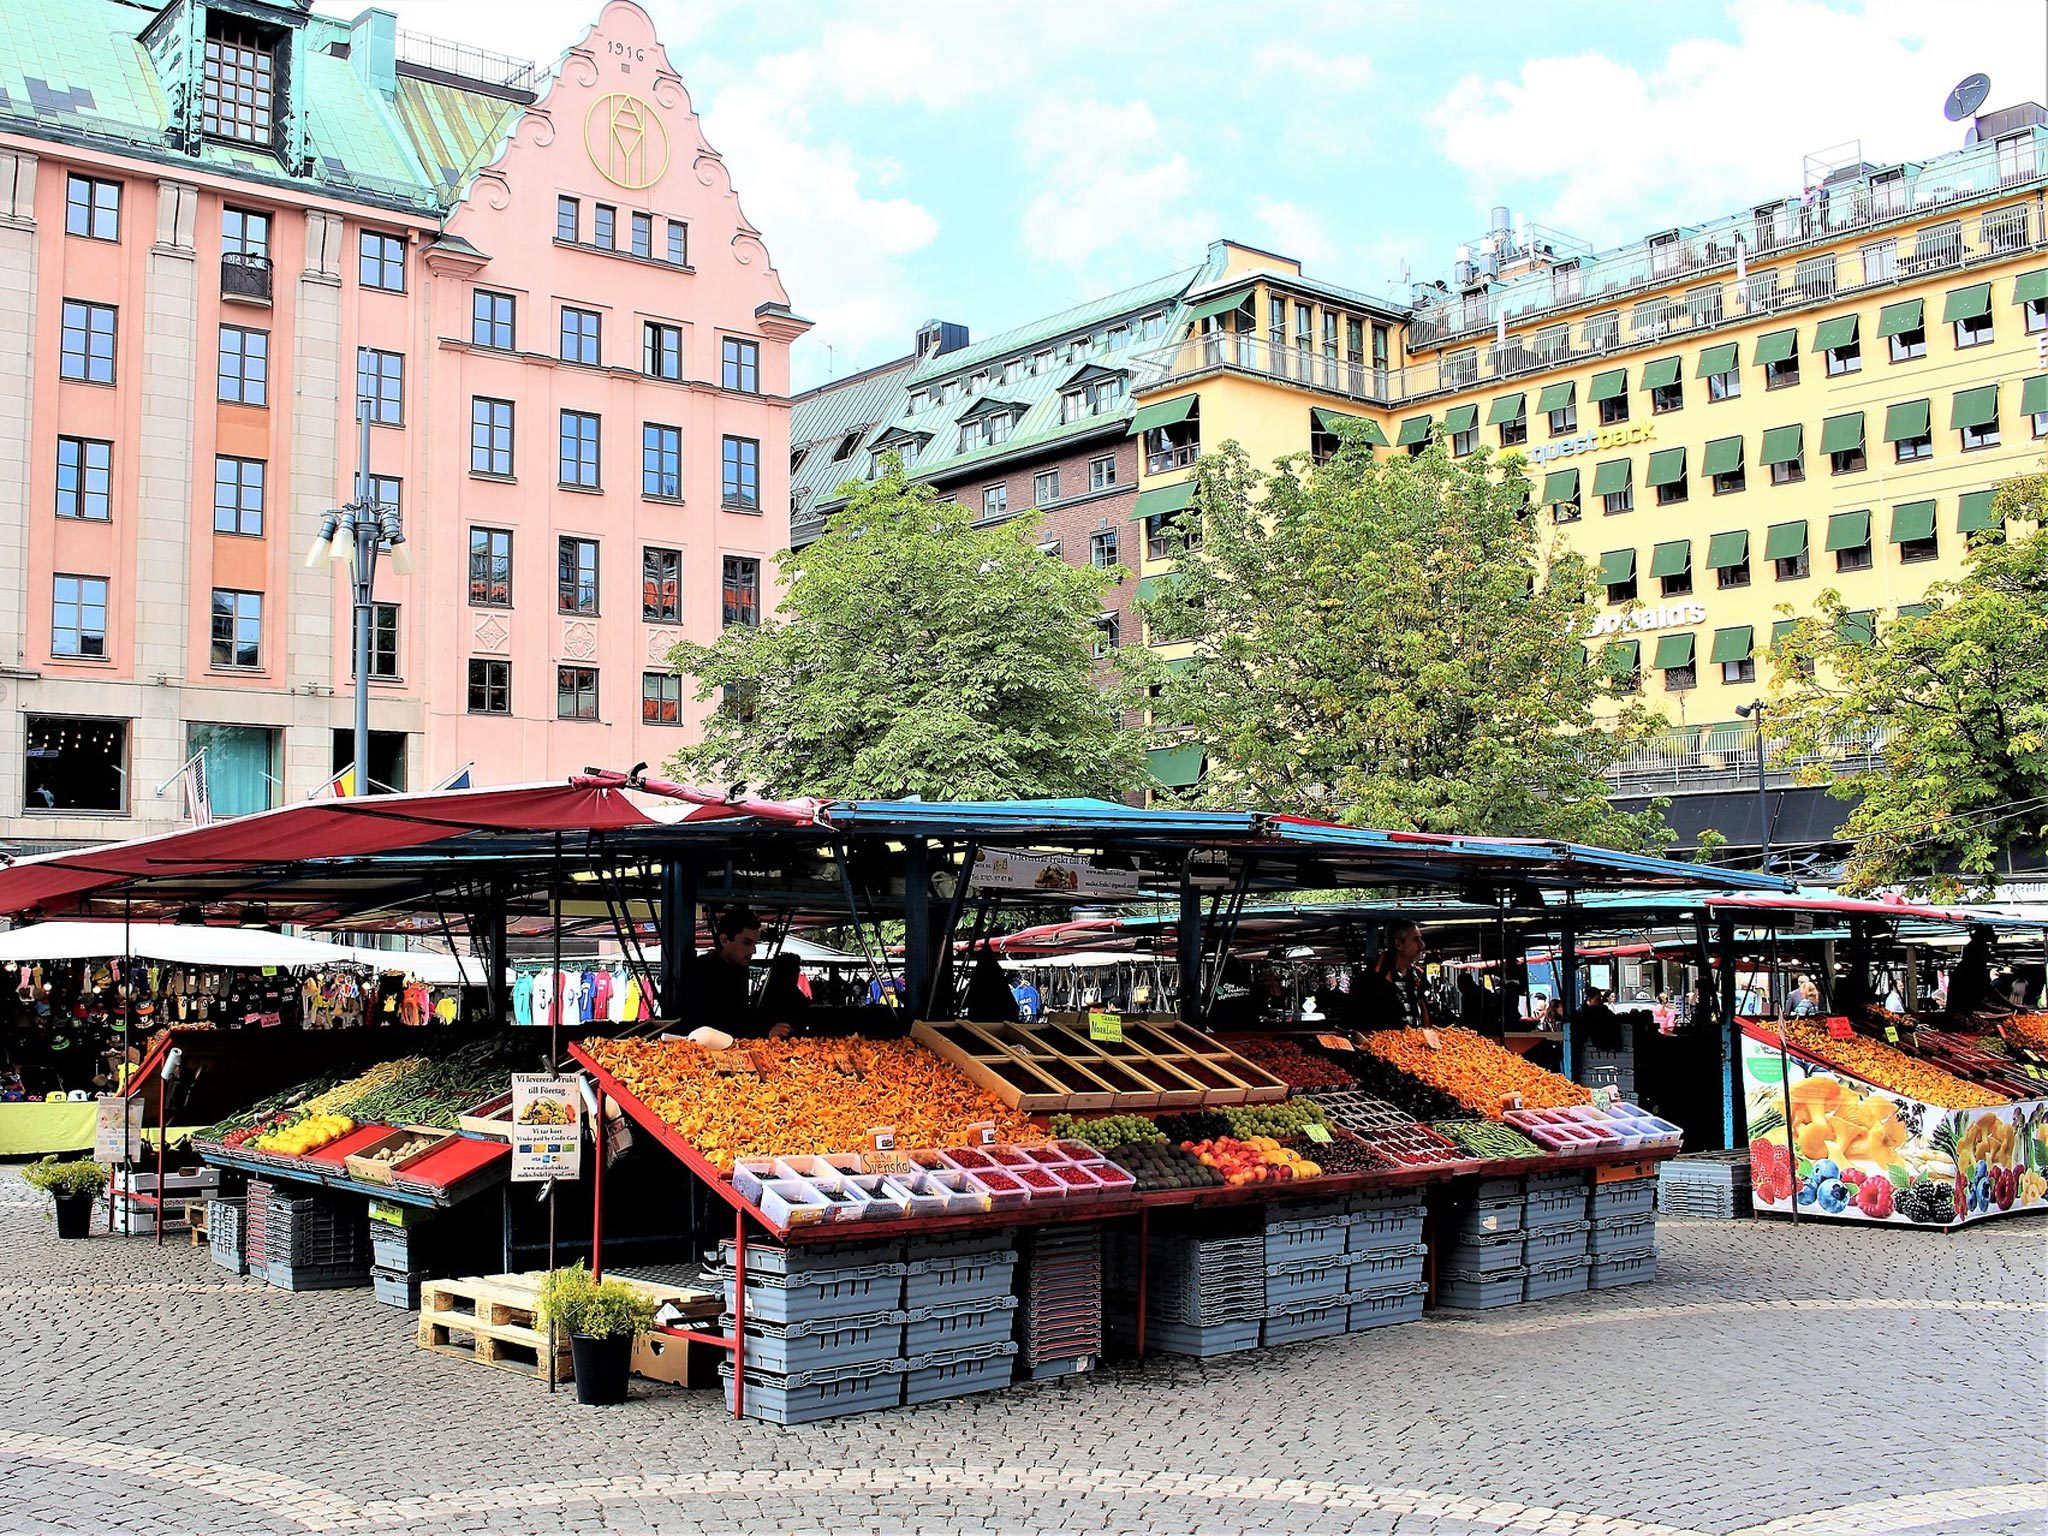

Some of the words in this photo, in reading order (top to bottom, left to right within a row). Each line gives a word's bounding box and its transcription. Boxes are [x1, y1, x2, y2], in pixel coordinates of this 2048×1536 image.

[607, 40, 644, 62] 1916
[1531, 415, 1657, 468] questback
[516, 1075, 525, 1083] Vi
[526, 1075, 557, 1083] leverera
[528, 1086, 539, 1094] till
[540, 1086, 566, 1096] Företag
